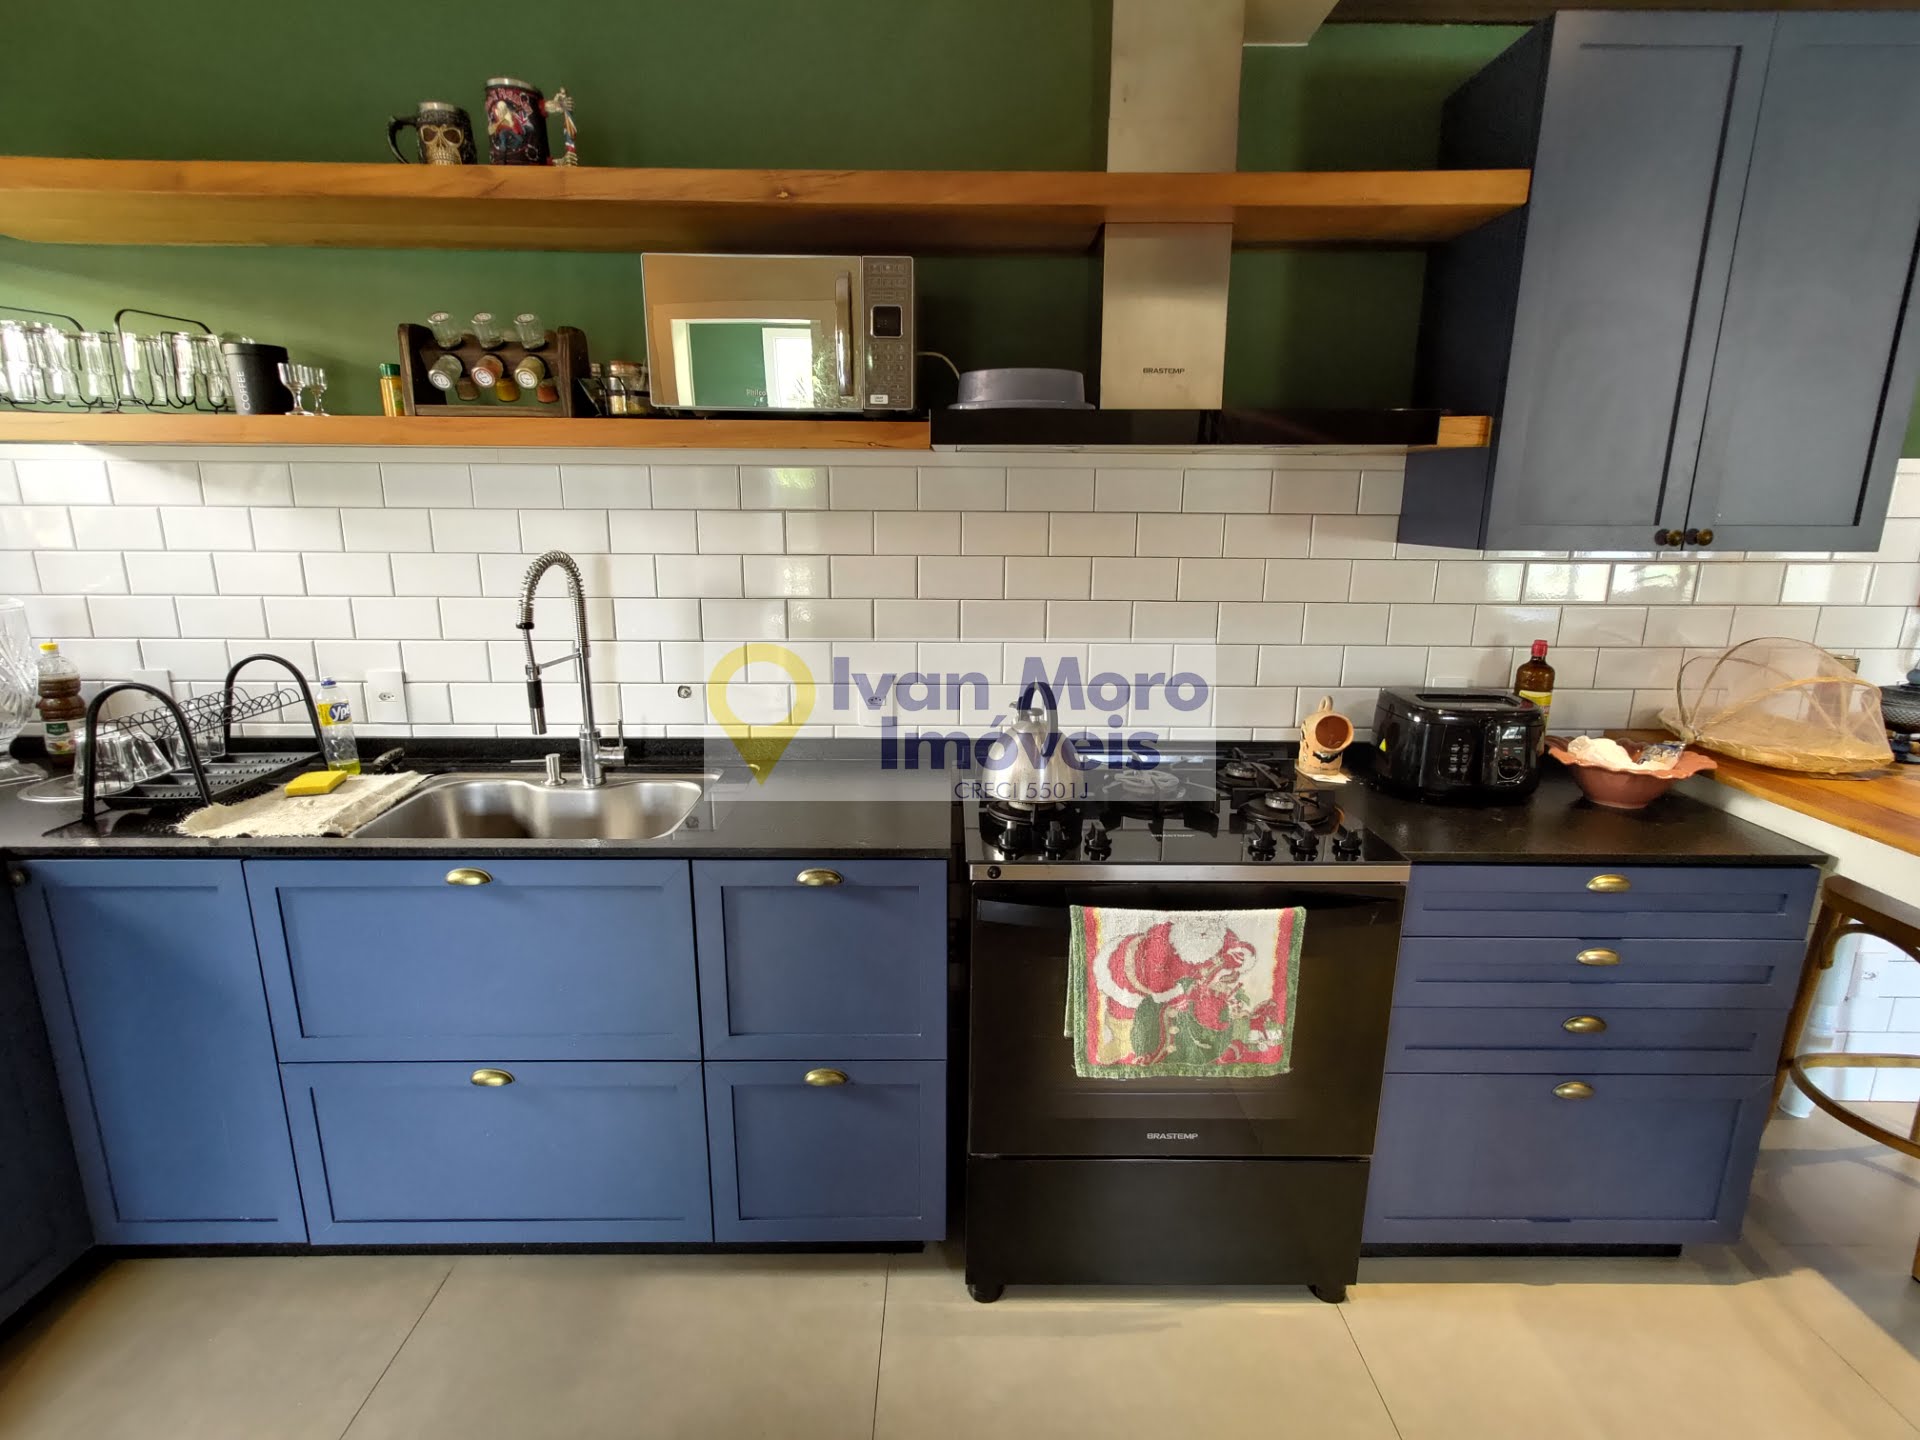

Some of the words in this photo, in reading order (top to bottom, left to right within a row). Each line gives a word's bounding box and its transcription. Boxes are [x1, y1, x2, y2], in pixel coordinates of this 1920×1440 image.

[1142, 367, 1185, 375] BRASTEMP
[236, 371, 251, 411] COFFEE
[1146, 1132, 1199, 1140] BRASTEMP
